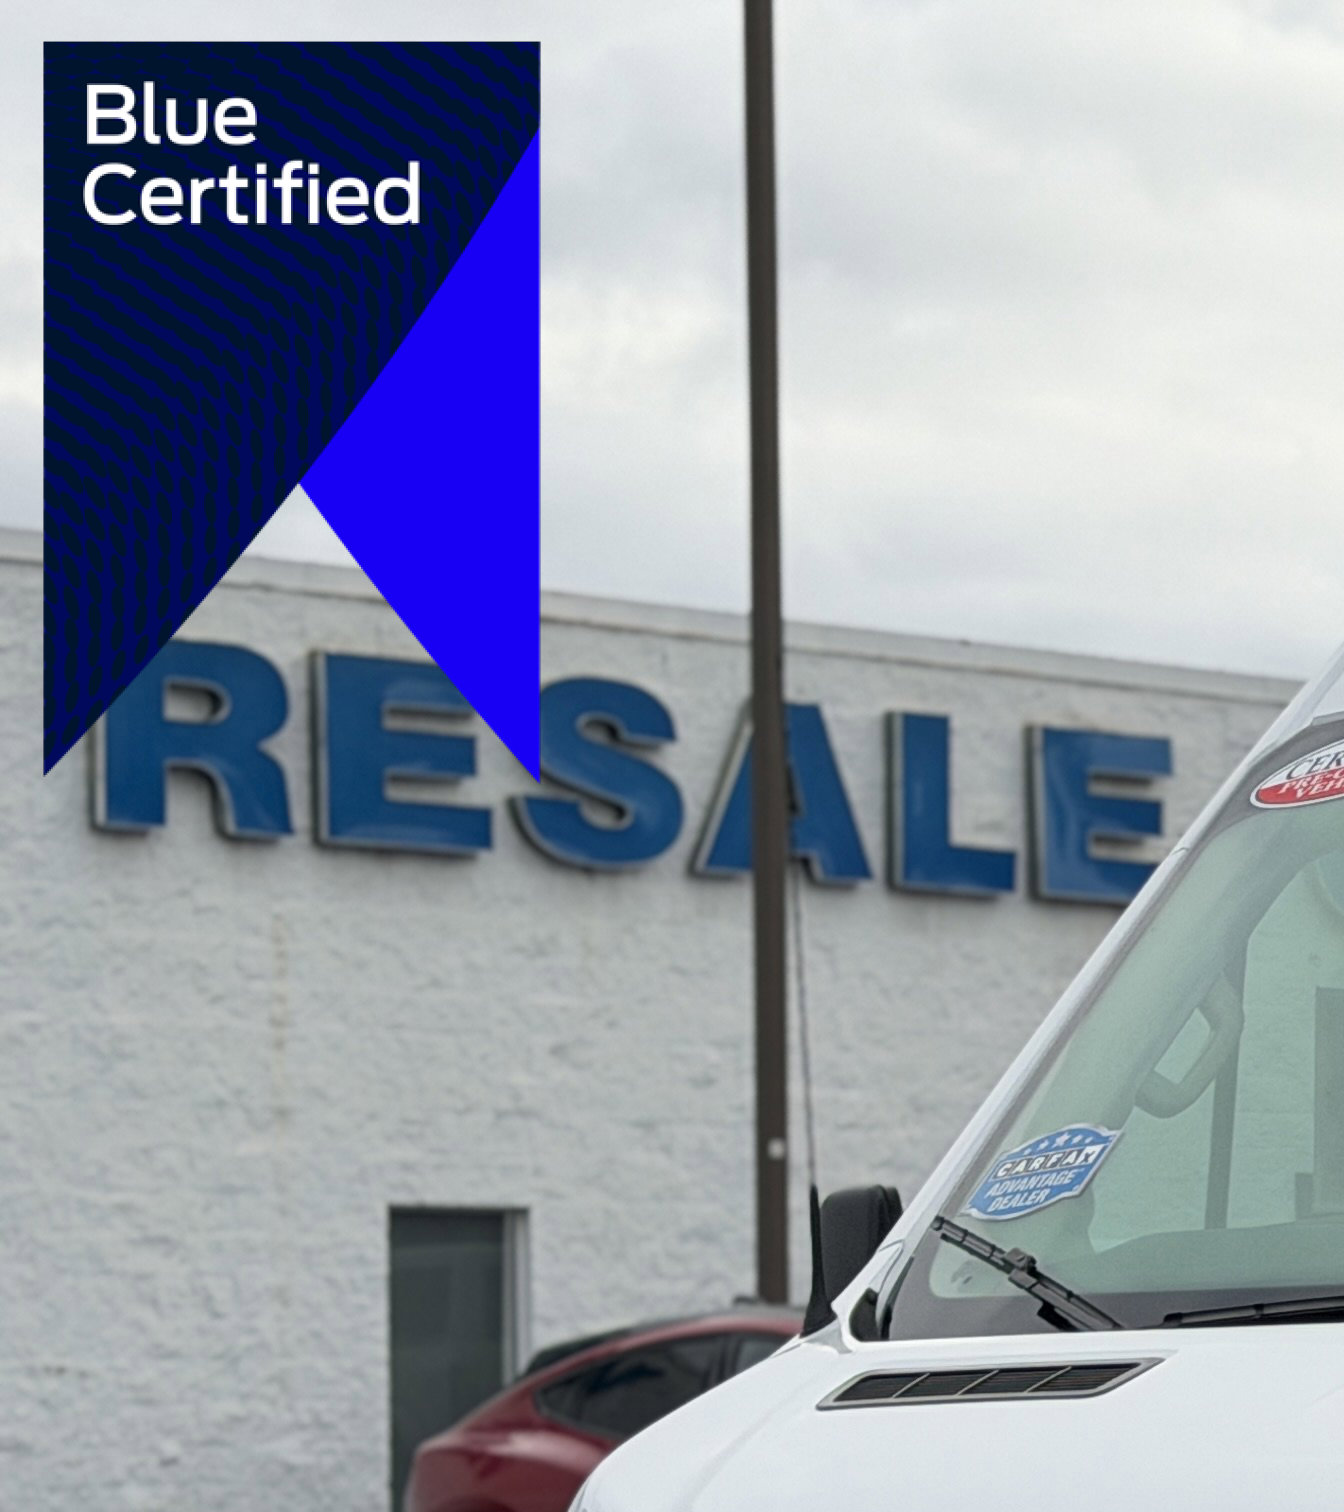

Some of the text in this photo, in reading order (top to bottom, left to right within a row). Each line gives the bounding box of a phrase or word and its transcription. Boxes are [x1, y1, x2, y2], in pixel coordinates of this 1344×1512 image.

[90, 638, 1174, 904] RESALE
[996, 1146, 1101, 1178] CARFAX
[985, 1167, 1083, 1199] ADVANTAGE
[987, 1188, 1051, 1213] DEALER
